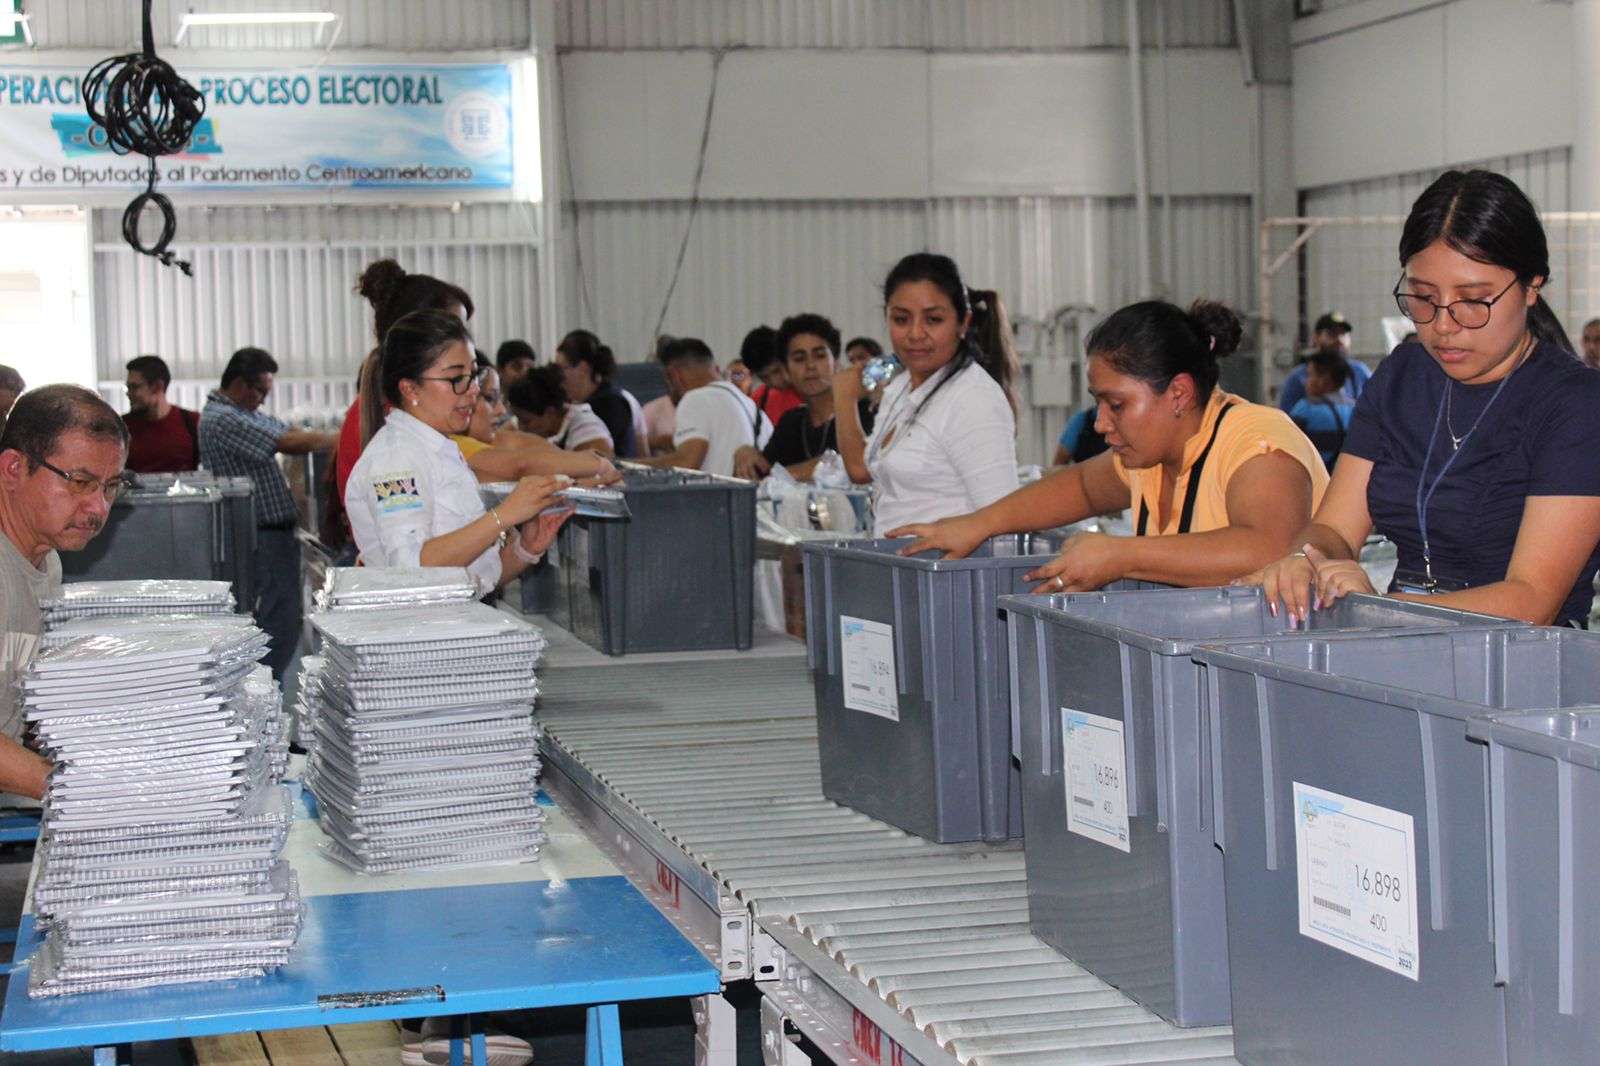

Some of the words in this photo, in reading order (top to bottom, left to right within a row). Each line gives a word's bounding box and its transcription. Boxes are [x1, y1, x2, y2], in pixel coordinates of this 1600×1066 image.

[201, 75, 310, 104] PROCESO
[319, 75, 444, 104] ELECTORAL
[13, 169, 24, 187] y
[30, 165, 56, 182] de
[168, 165, 184, 181] al
[191, 164, 300, 182] Parlamento
[306, 162, 473, 182] Centroamericano
[1354, 863, 1402, 902] 16,898
[1369, 913, 1388, 932] 400
